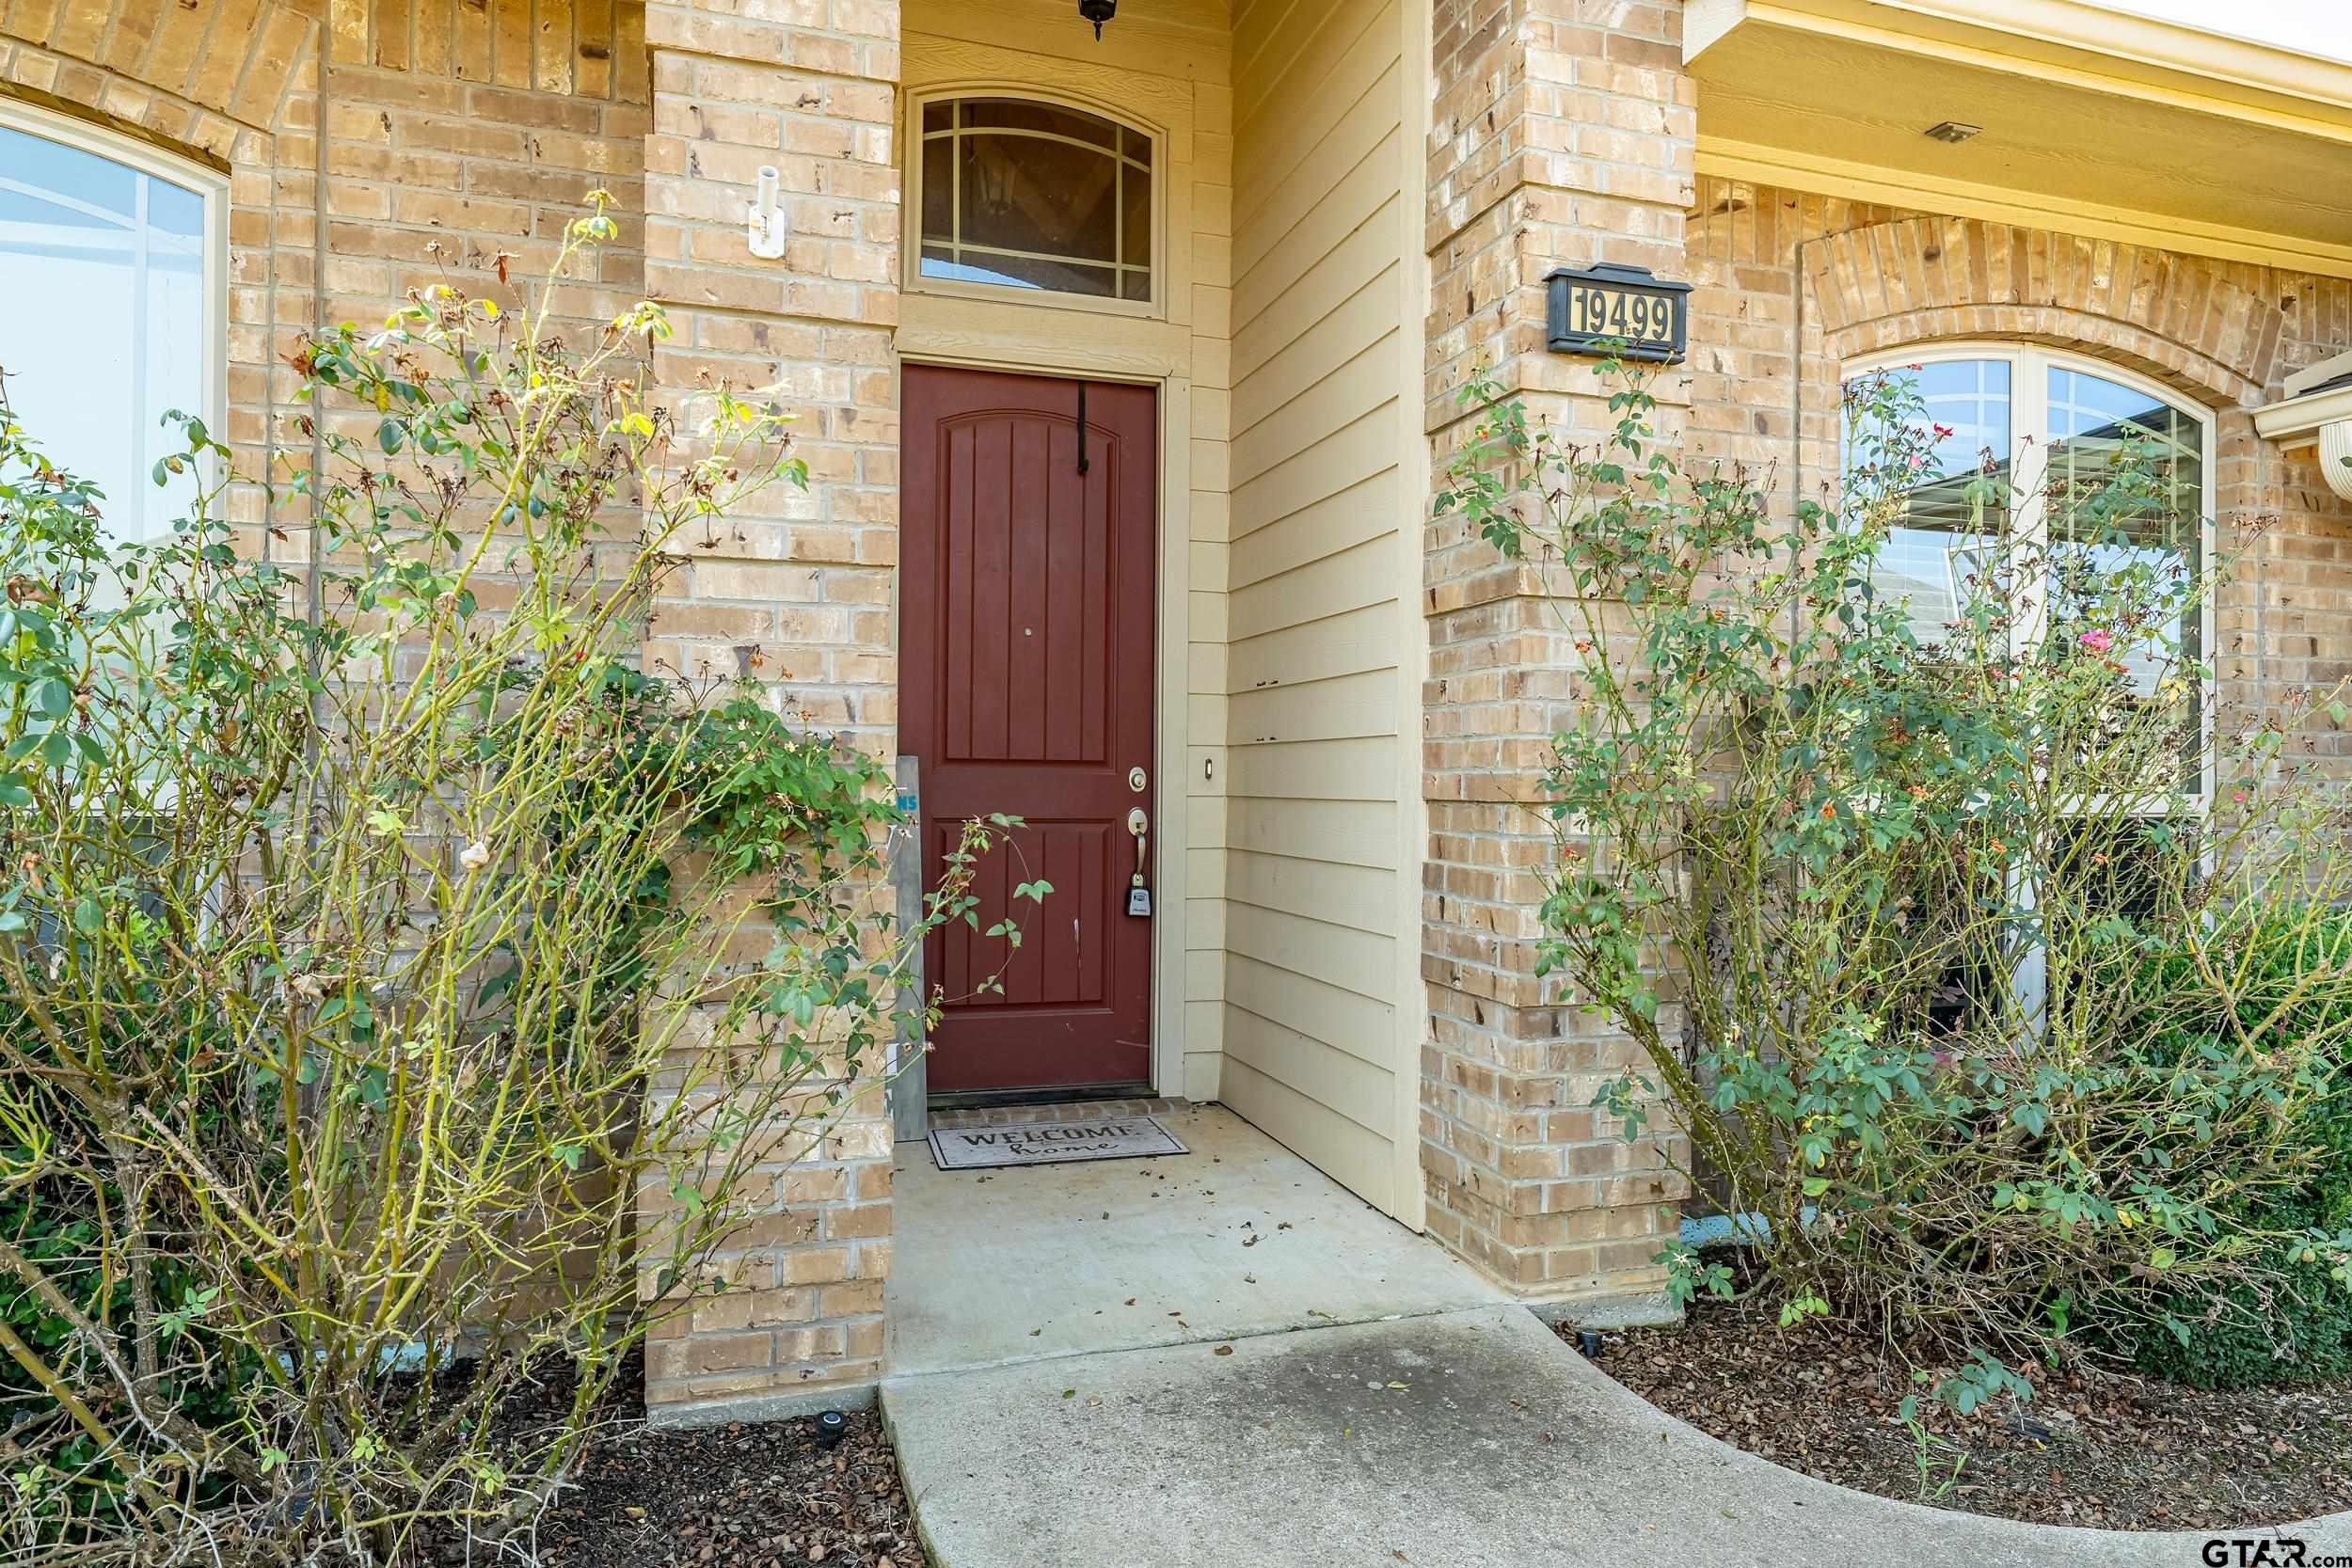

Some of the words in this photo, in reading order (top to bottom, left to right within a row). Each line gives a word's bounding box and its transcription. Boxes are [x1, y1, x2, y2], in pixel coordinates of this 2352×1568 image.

[1575, 287, 1669, 341] 19499
[961, 1124, 1136, 1146] WELCOME
[1009, 1142, 1120, 1156] home
